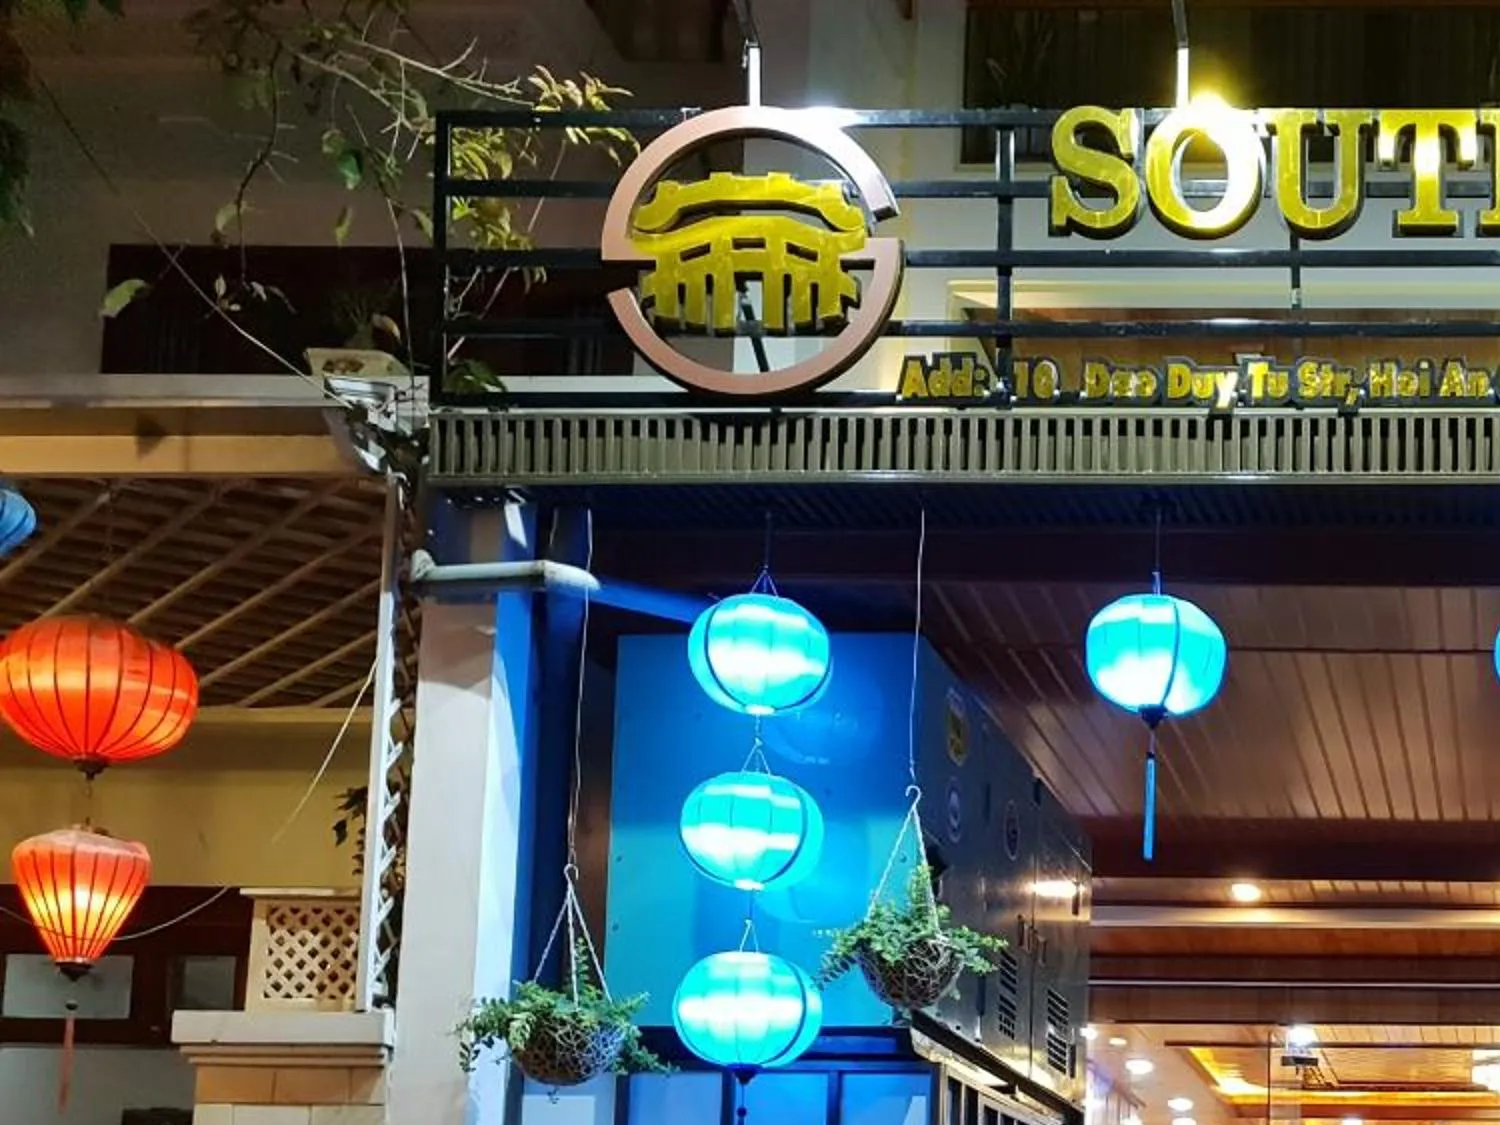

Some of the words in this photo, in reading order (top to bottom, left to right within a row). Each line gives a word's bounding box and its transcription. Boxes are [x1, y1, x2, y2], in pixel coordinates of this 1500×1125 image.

[901, 356, 988, 399] Add:
[1166, 362, 1238, 409] Duy
[1368, 359, 1431, 398] Hoi
[1438, 359, 1490, 398] An
